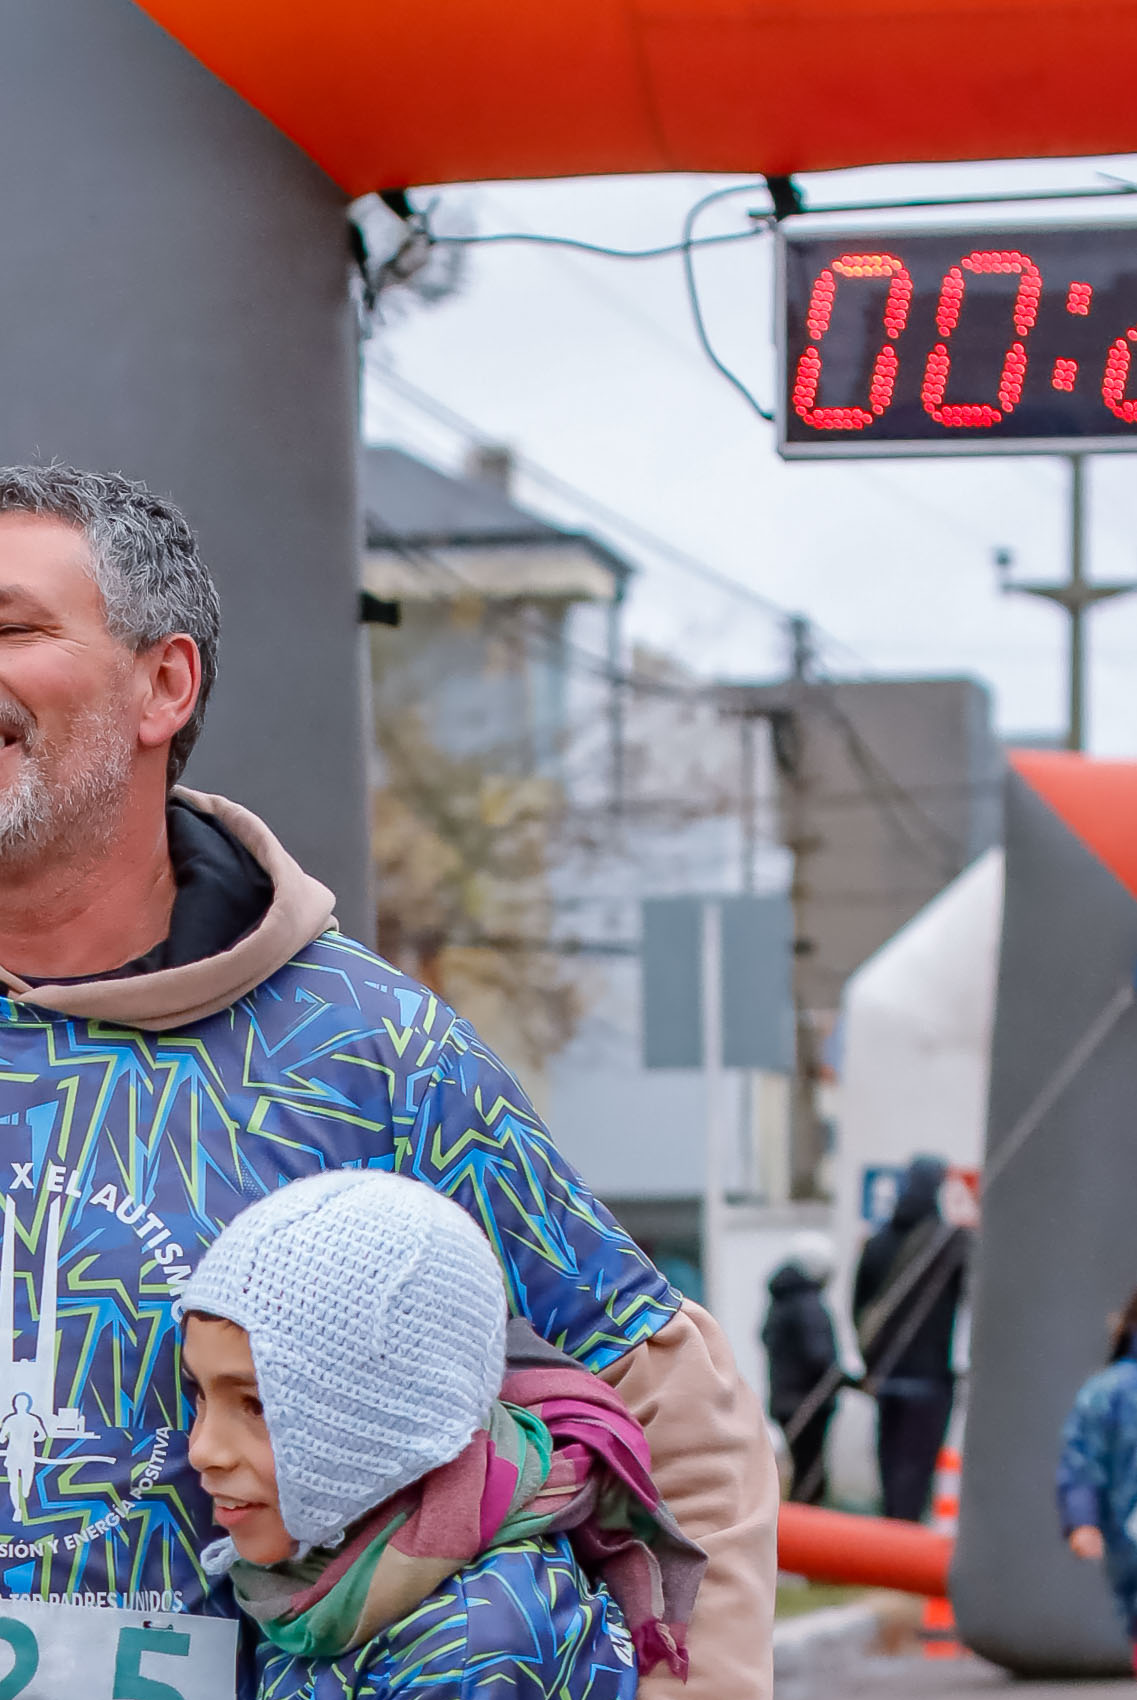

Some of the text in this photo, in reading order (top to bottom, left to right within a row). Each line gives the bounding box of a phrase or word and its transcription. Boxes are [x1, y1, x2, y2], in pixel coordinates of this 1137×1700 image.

[9, 1162, 35, 1190] X
[47, 1165, 82, 1198] EL
[47, 1539, 60, 1555] Y
[63, 1499, 136, 1551] ENERGÍA
[129, 1426, 171, 1501] POSITIVA
[123, 1590, 183, 1613] UNIDOS
